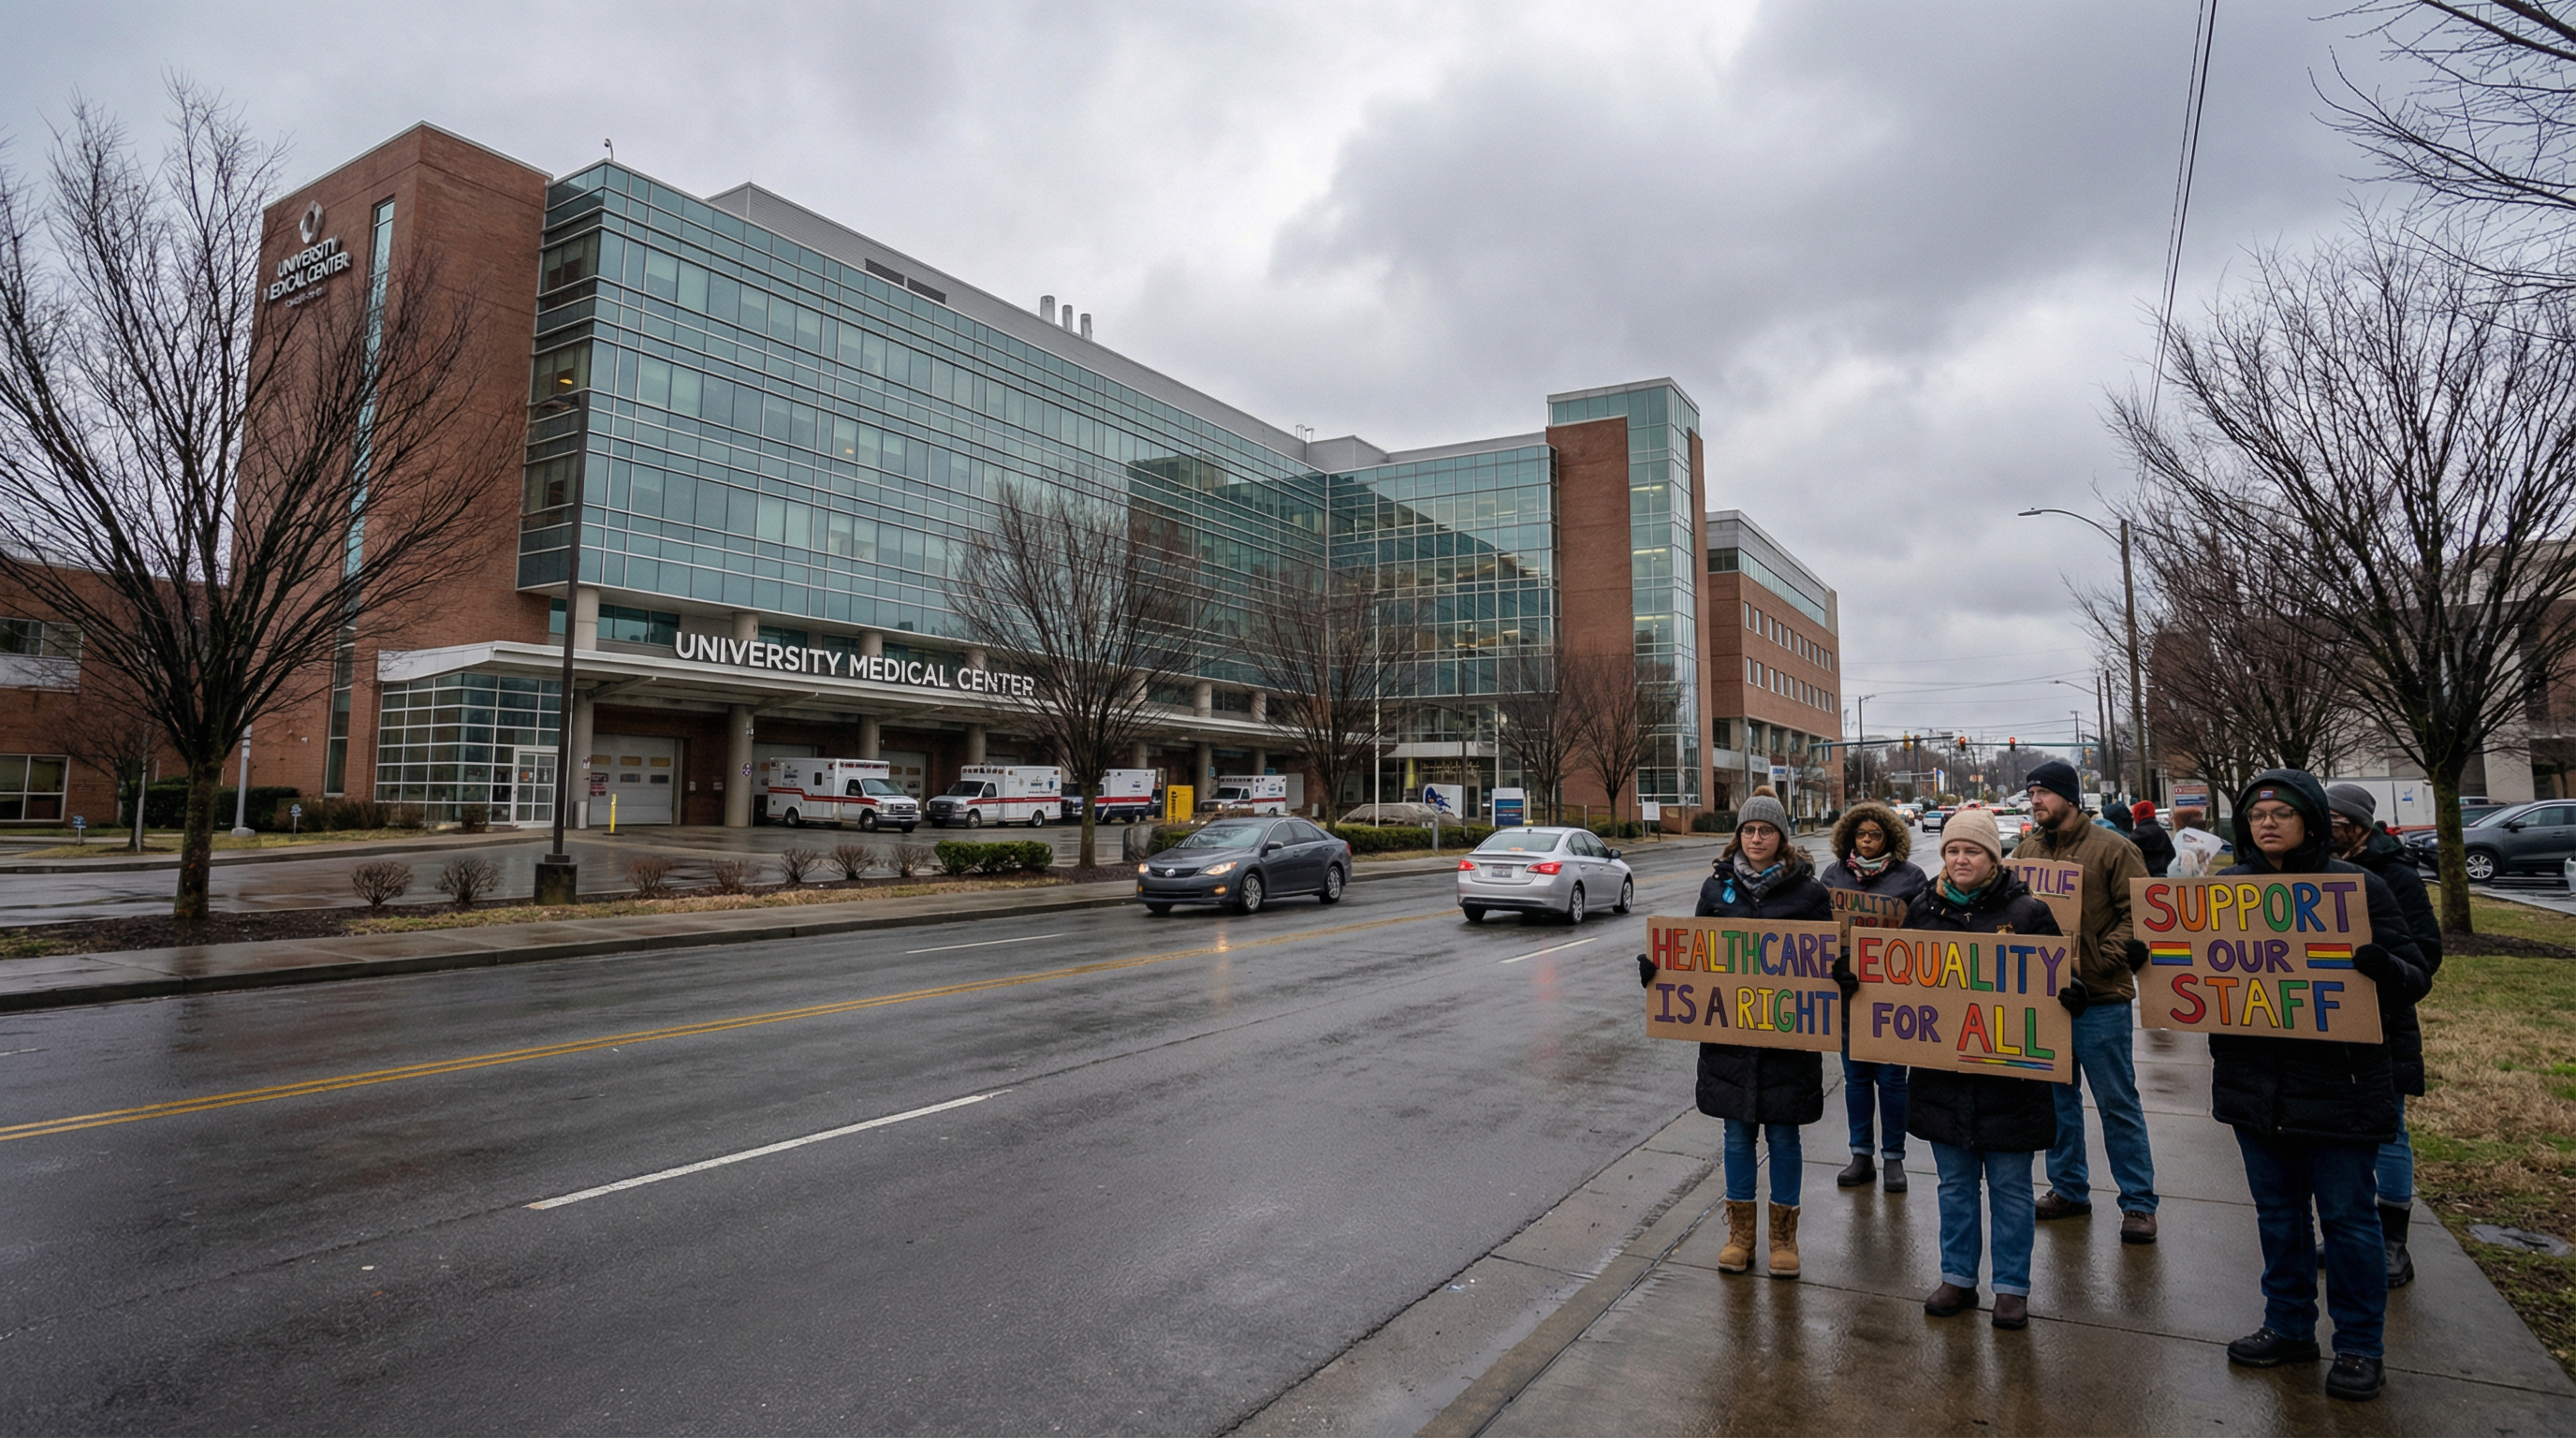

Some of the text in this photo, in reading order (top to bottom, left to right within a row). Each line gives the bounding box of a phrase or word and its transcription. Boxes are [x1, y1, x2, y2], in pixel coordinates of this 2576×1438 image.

[278, 234, 338, 277] UNIVERSITY
[307, 251, 350, 283] CENTER
[675, 631, 1035, 697] UNIVERSITY MEDICAL CENTER
[2144, 881, 2358, 933] SUPPORT
[1652, 927, 1837, 979] HEALTHCARE
[1858, 936, 2067, 997] EQUALITY
[2207, 939, 2295, 974] OUR
[1654, 983, 1839, 1036] IS A RIGHT
[2170, 973, 2345, 1033] STAFF
[1872, 1002, 2056, 1060] FOR ALL
